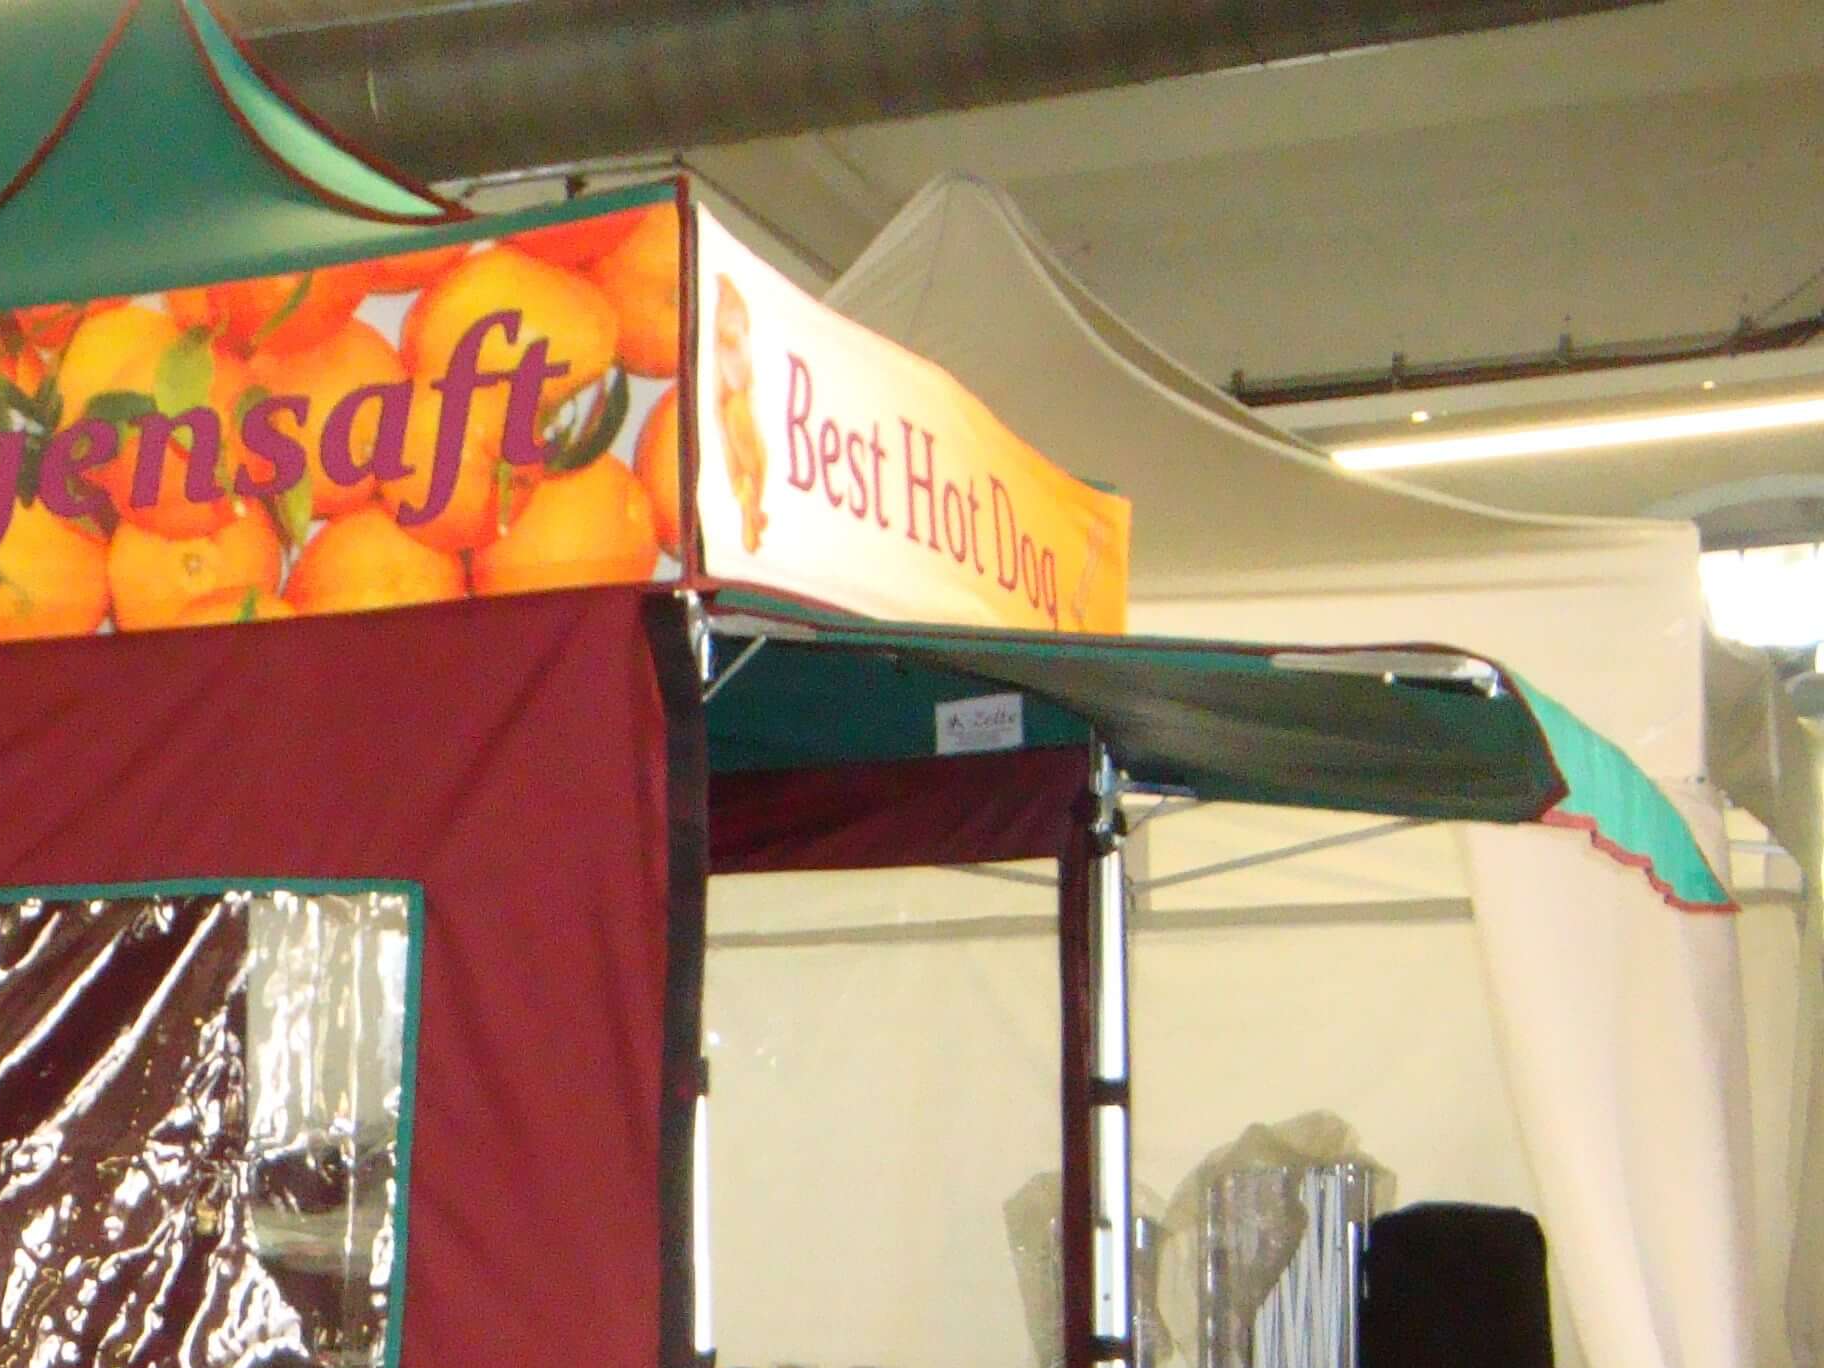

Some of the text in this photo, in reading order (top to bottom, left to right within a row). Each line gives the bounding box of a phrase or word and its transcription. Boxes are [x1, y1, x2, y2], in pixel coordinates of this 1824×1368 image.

[786, 350, 1060, 632] Best Hot Dog
